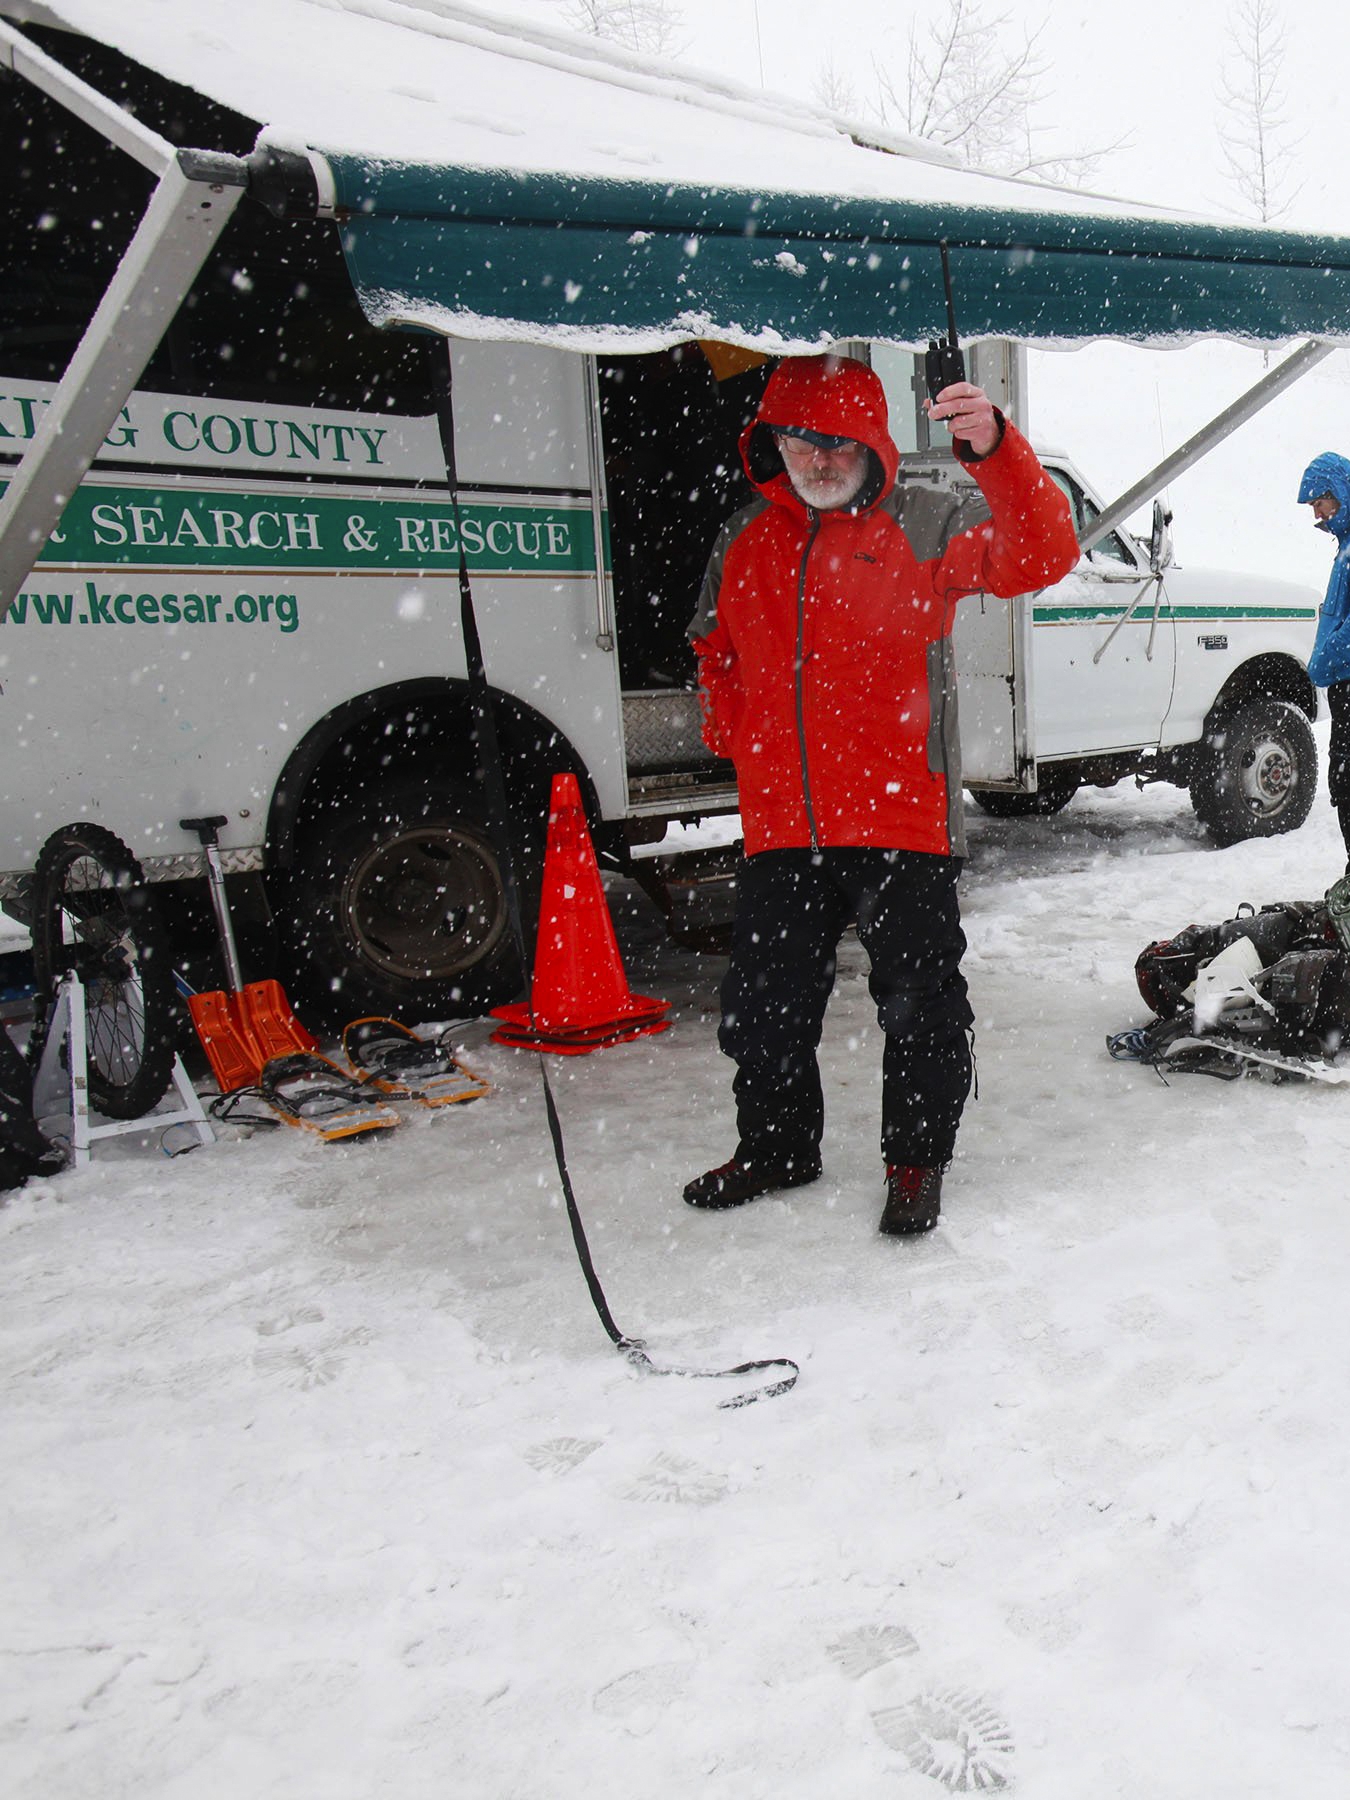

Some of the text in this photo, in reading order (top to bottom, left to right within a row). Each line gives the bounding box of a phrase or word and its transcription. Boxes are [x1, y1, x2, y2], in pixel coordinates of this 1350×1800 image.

[0, 395, 387, 464] IG COUNTY
[91, 504, 572, 556] SEARCH & RESCUE
